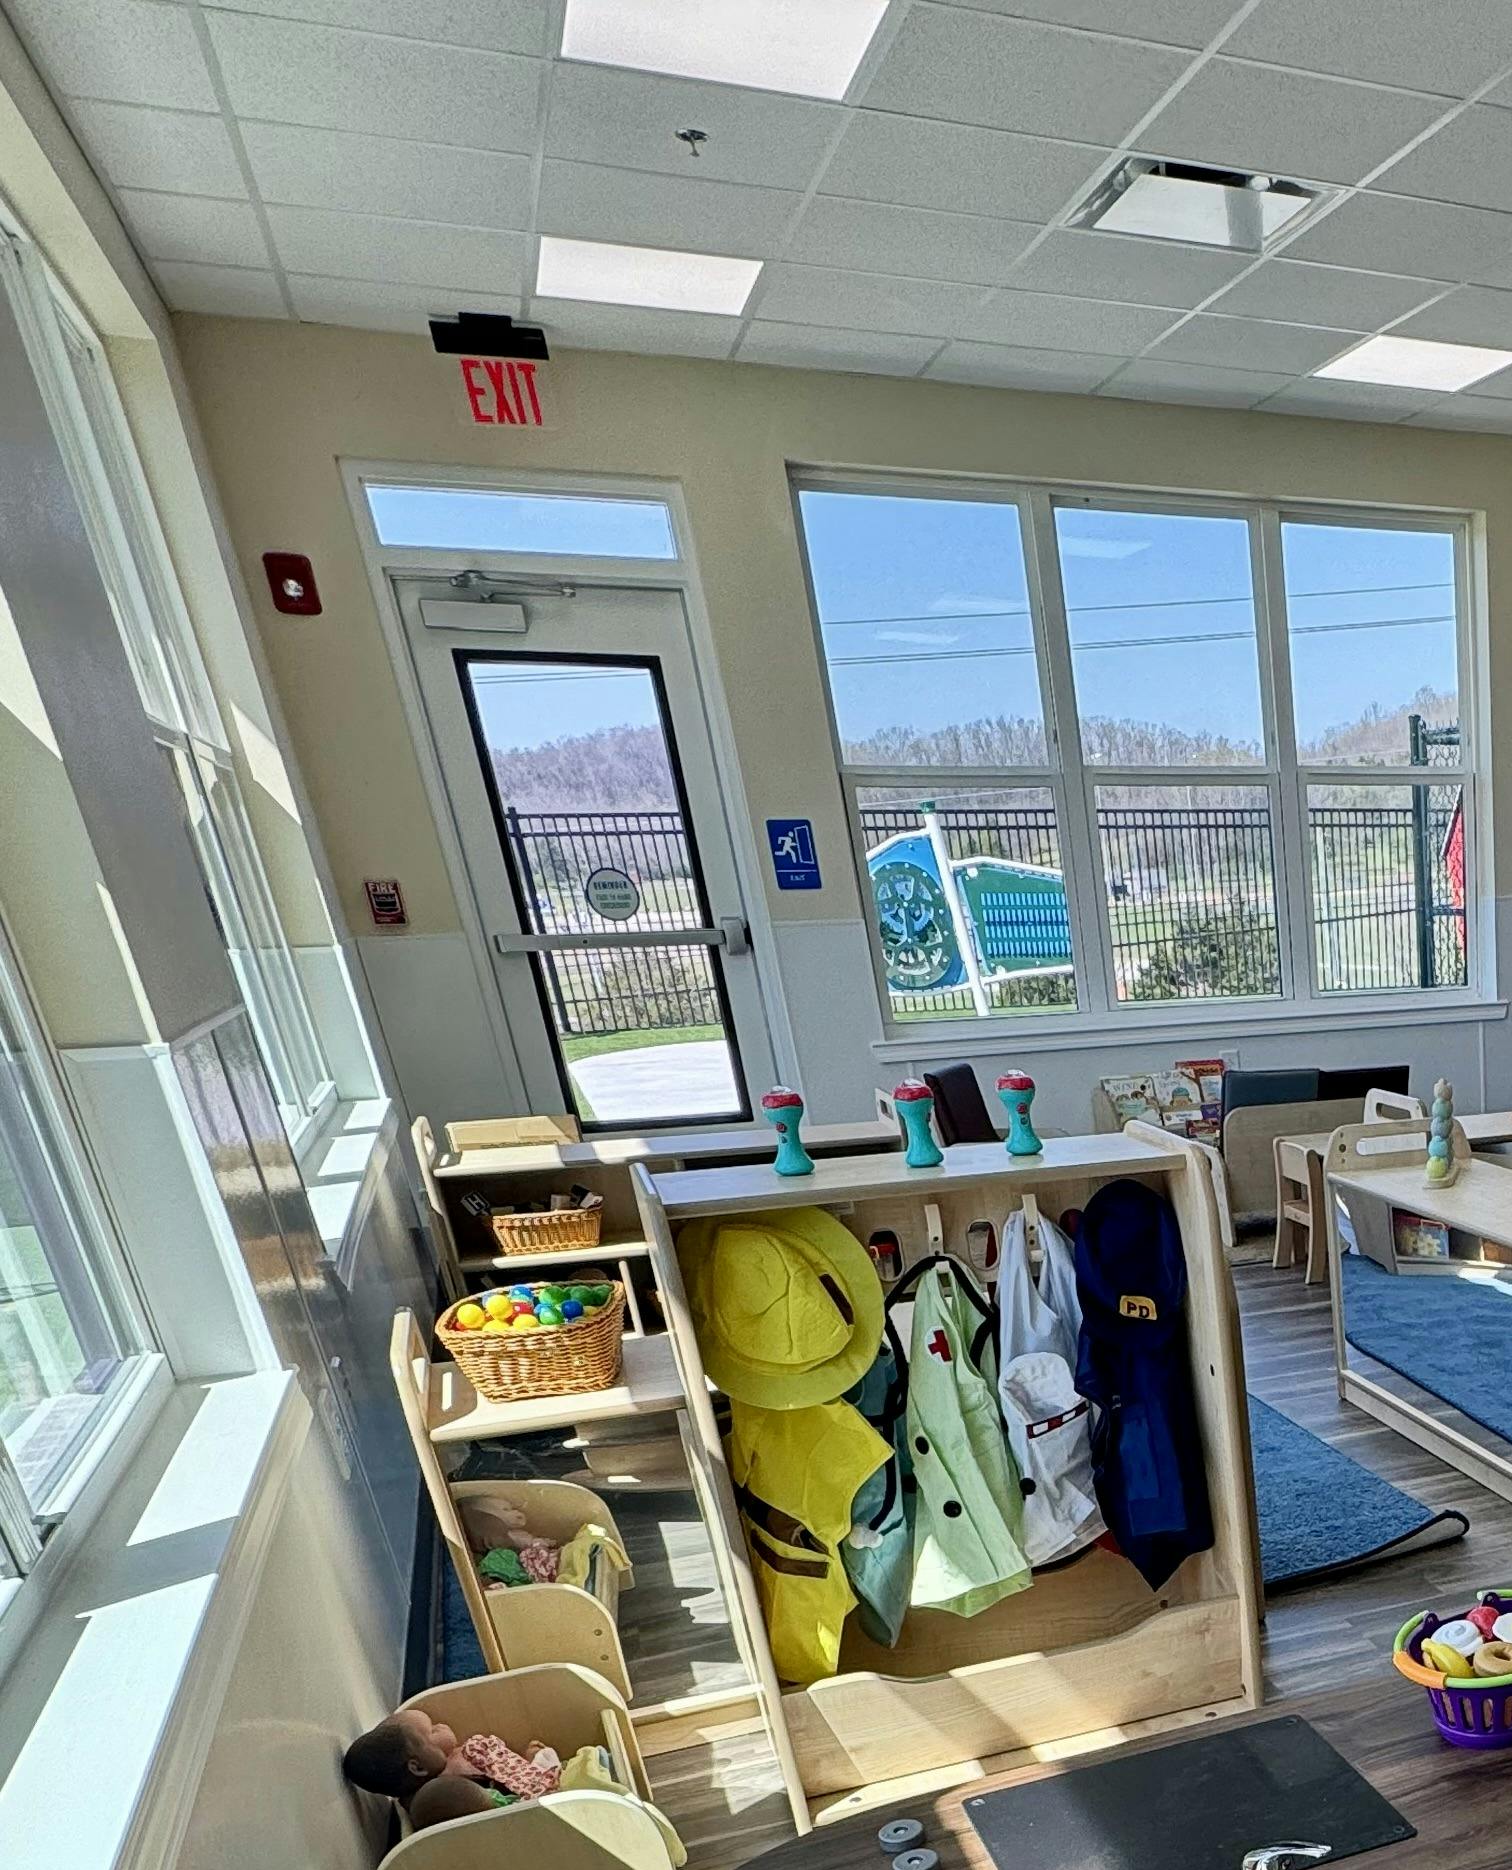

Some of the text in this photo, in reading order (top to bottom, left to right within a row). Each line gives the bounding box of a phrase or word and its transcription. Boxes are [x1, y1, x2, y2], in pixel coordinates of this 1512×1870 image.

[460, 358, 543, 427] EXIT
[367, 882, 397, 894] FIRE
[1126, 1301, 1151, 1318] PD
